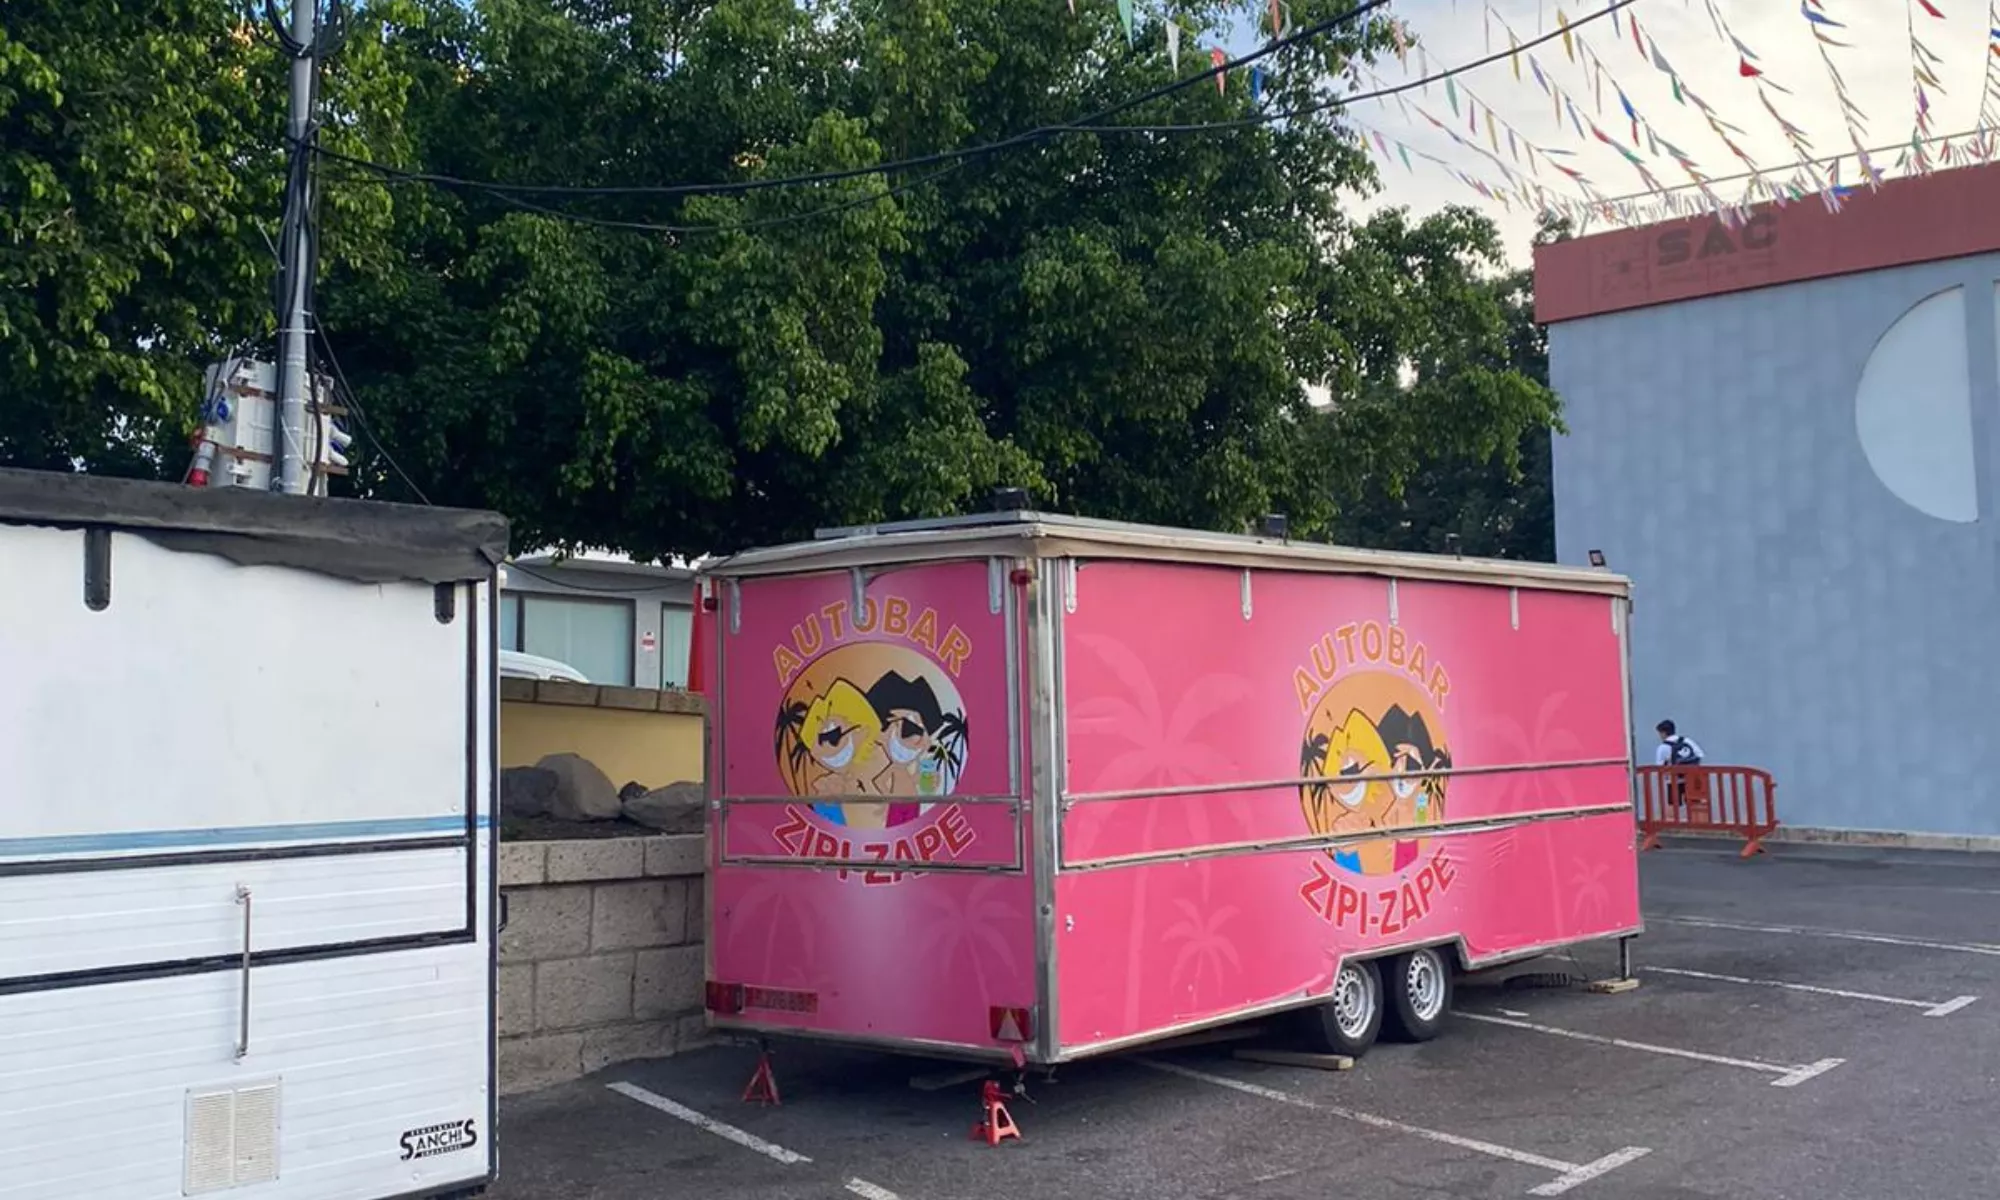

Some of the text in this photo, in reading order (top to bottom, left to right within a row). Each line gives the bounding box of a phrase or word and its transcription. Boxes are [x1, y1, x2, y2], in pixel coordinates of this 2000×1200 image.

[772, 595, 973, 687] AUTOBAR
[1293, 619, 1451, 715] AUTOBAR
[772, 804, 977, 888] ZIPIZAPE
[1298, 845, 1458, 937] ZIPI-ZAPE
[400, 1118, 478, 1161] SANCHIS
